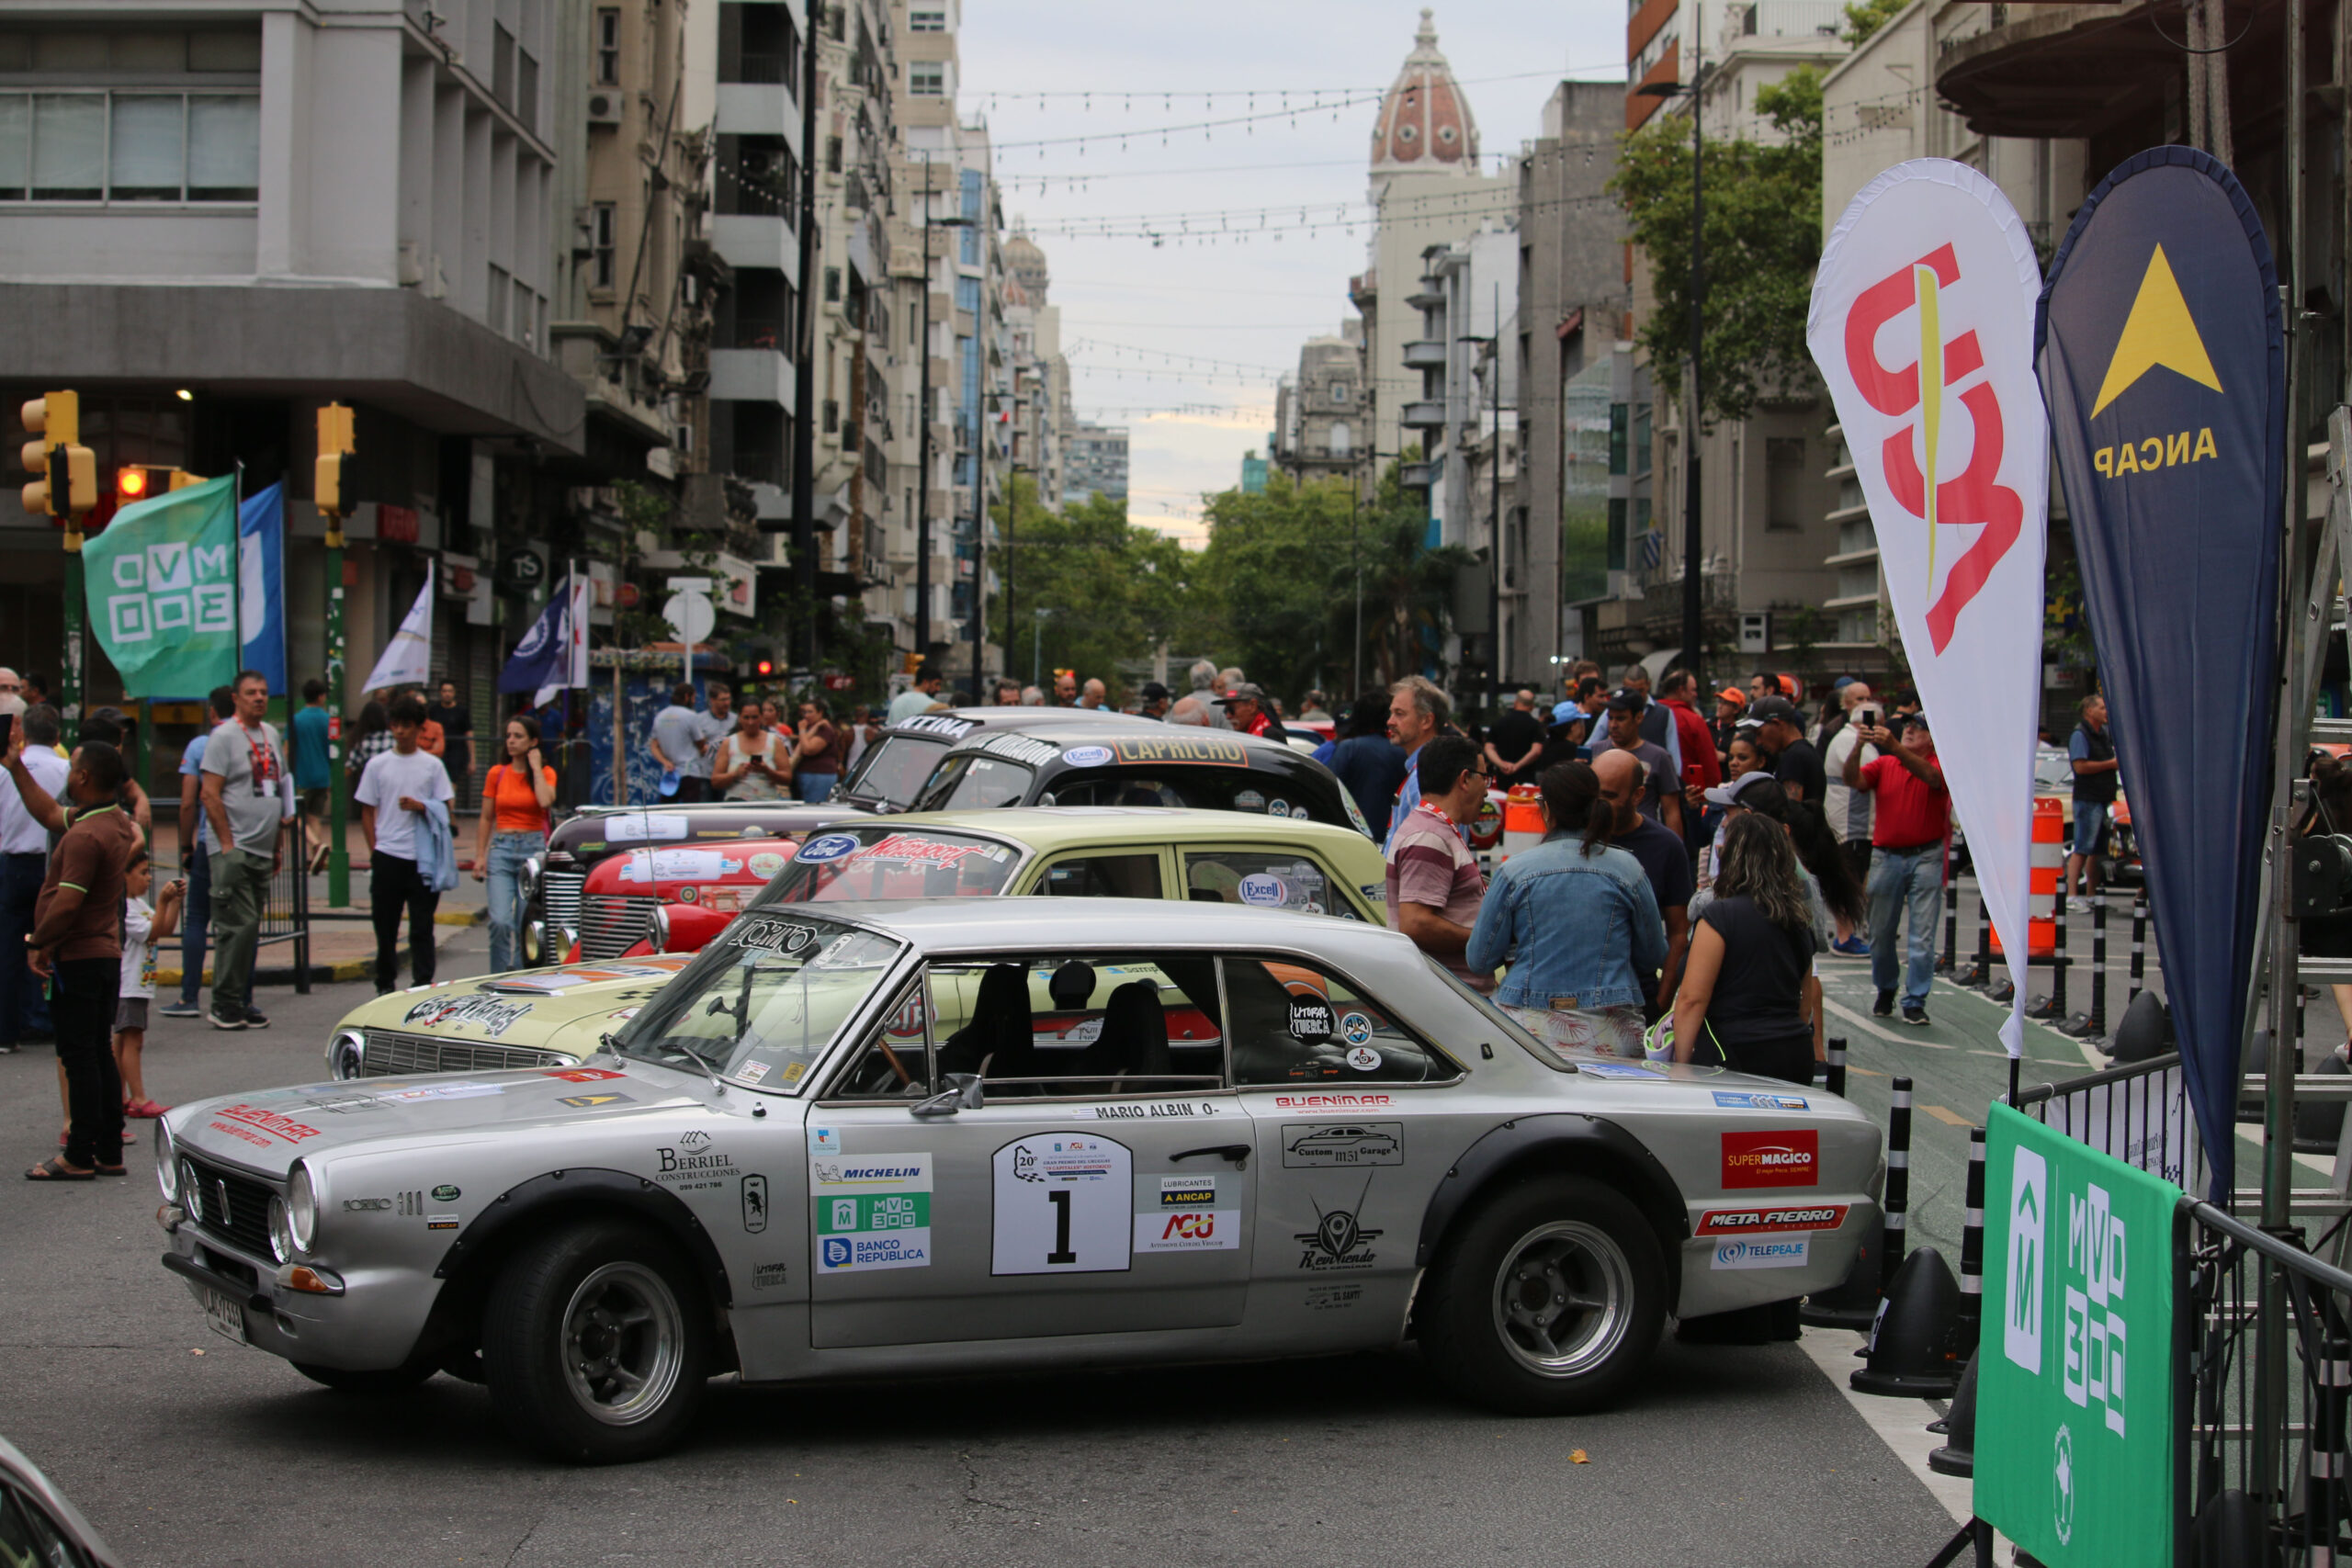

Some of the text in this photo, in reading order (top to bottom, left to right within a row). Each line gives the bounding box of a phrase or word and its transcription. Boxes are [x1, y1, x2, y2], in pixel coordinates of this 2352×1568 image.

[1070, 749, 1103, 761] Excell
[1119, 739, 1241, 761] CAPRICHO
[805, 837, 848, 857] Ford
[1246, 882, 1279, 897] Excell
[1294, 1020, 1329, 1034] TUERCA
[1095, 1105, 1145, 1118] MARIO
[1149, 1103, 1194, 1116] ALBIN
[1298, 1148, 1332, 1156] Custom
[1360, 1147, 1391, 1156] Garage
[1728, 1152, 1812, 1166] SUPERMAGICO
[656, 1147, 733, 1172] BERRIEL
[655, 1168, 741, 1182] CONSTRUCCIONES
[843, 1168, 921, 1179] MICHELIN
[1163, 1179, 1213, 1188] LUBRICANTES
[1175, 1192, 1212, 1201] ANCAP
[874, 1197, 914, 1213] MVD
[872, 1212, 916, 1228] 300
[1709, 1209, 1836, 1226] META FIERRO
[1046, 1190, 1077, 1265] 1
[856, 1239, 900, 1252] BANCO
[1748, 1243, 1804, 1257] TELEPEAJE
[2067, 1181, 2126, 1309] MVD
[856, 1248, 924, 1263] REPÚBLICA
[2063, 1283, 2126, 1437] 300
